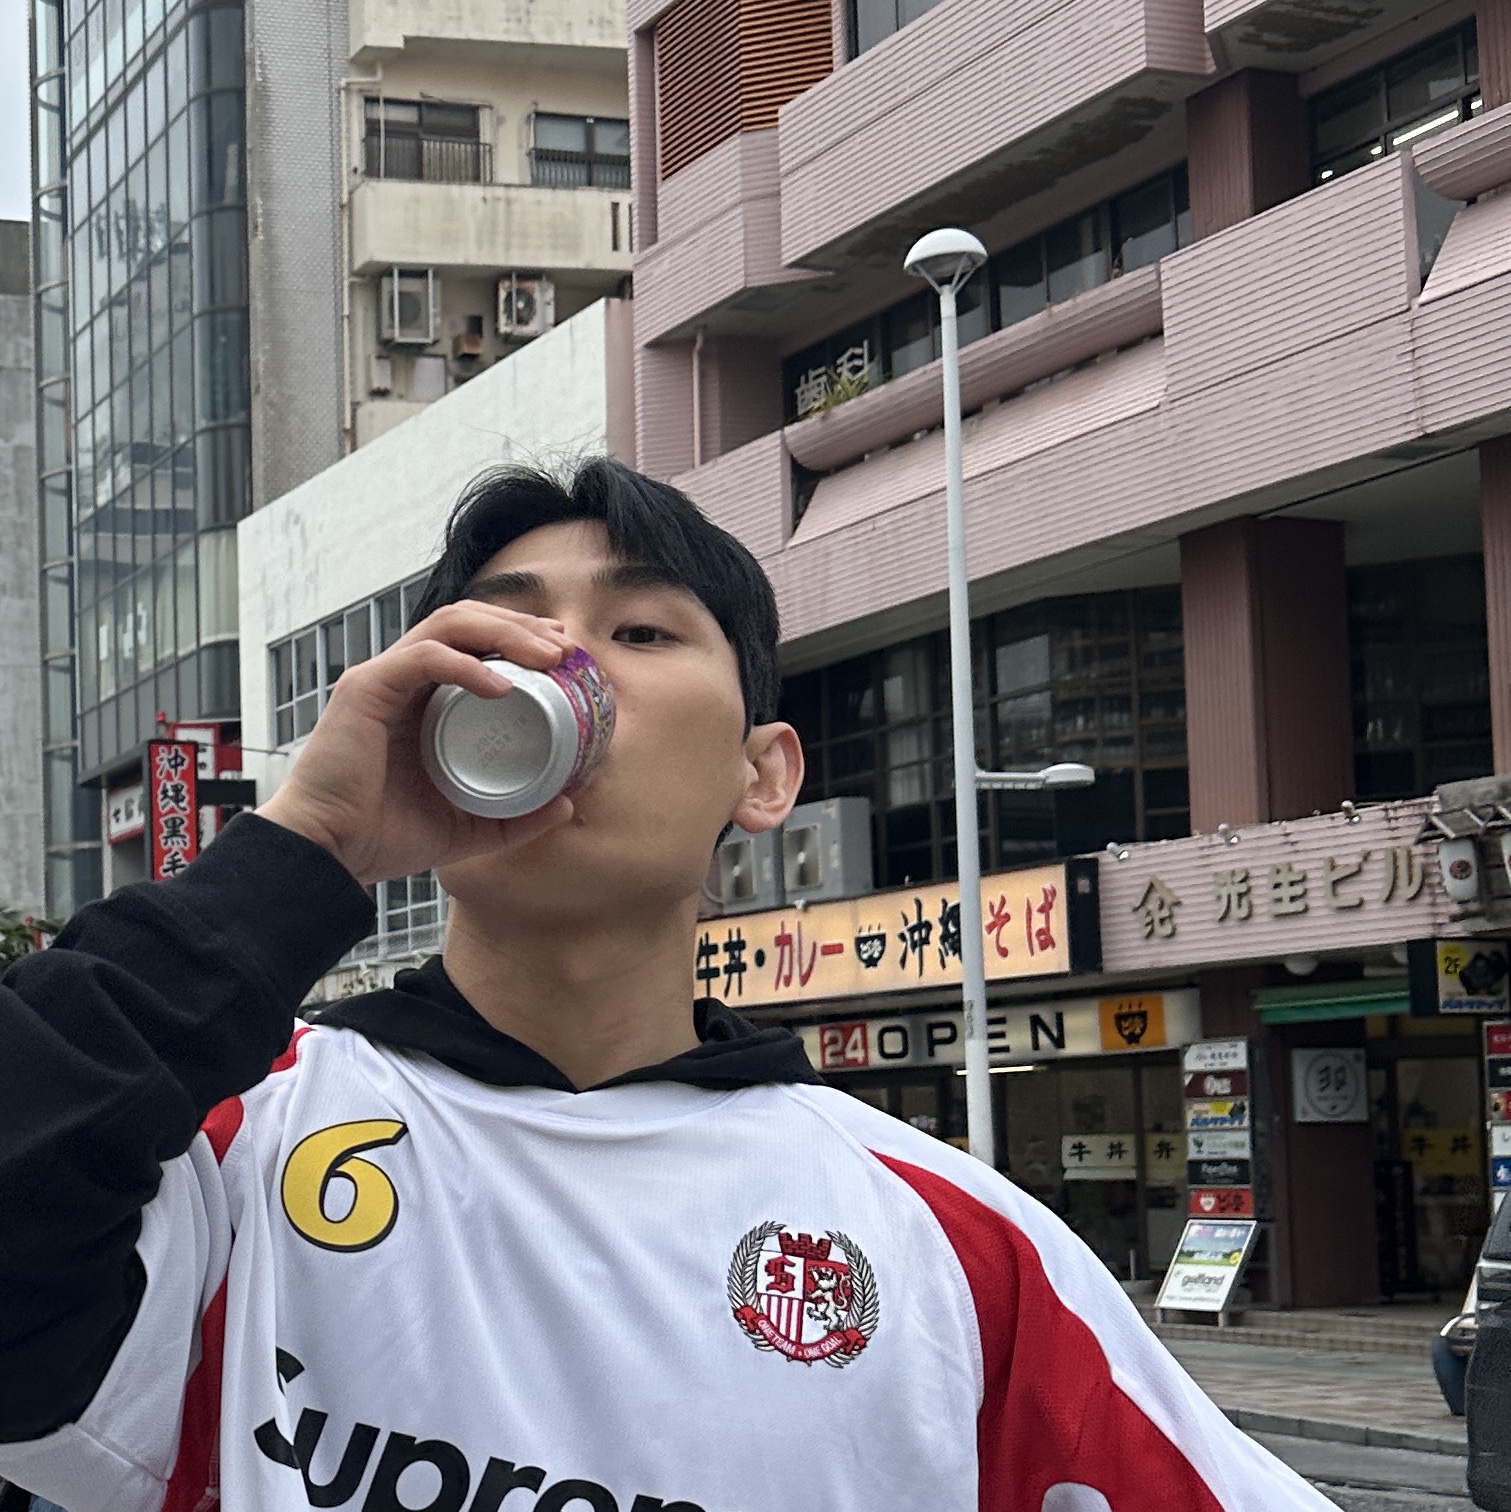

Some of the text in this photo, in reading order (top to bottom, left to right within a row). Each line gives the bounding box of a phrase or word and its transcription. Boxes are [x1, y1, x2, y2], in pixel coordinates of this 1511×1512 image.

[794, 339, 869, 416] 歯科
[823, 1026, 866, 1065] 24
[877, 1011, 1067, 1060] OPEN
[1067, 1141, 1127, 1163] 牛丼
[280, 1118, 408, 1253] 6
